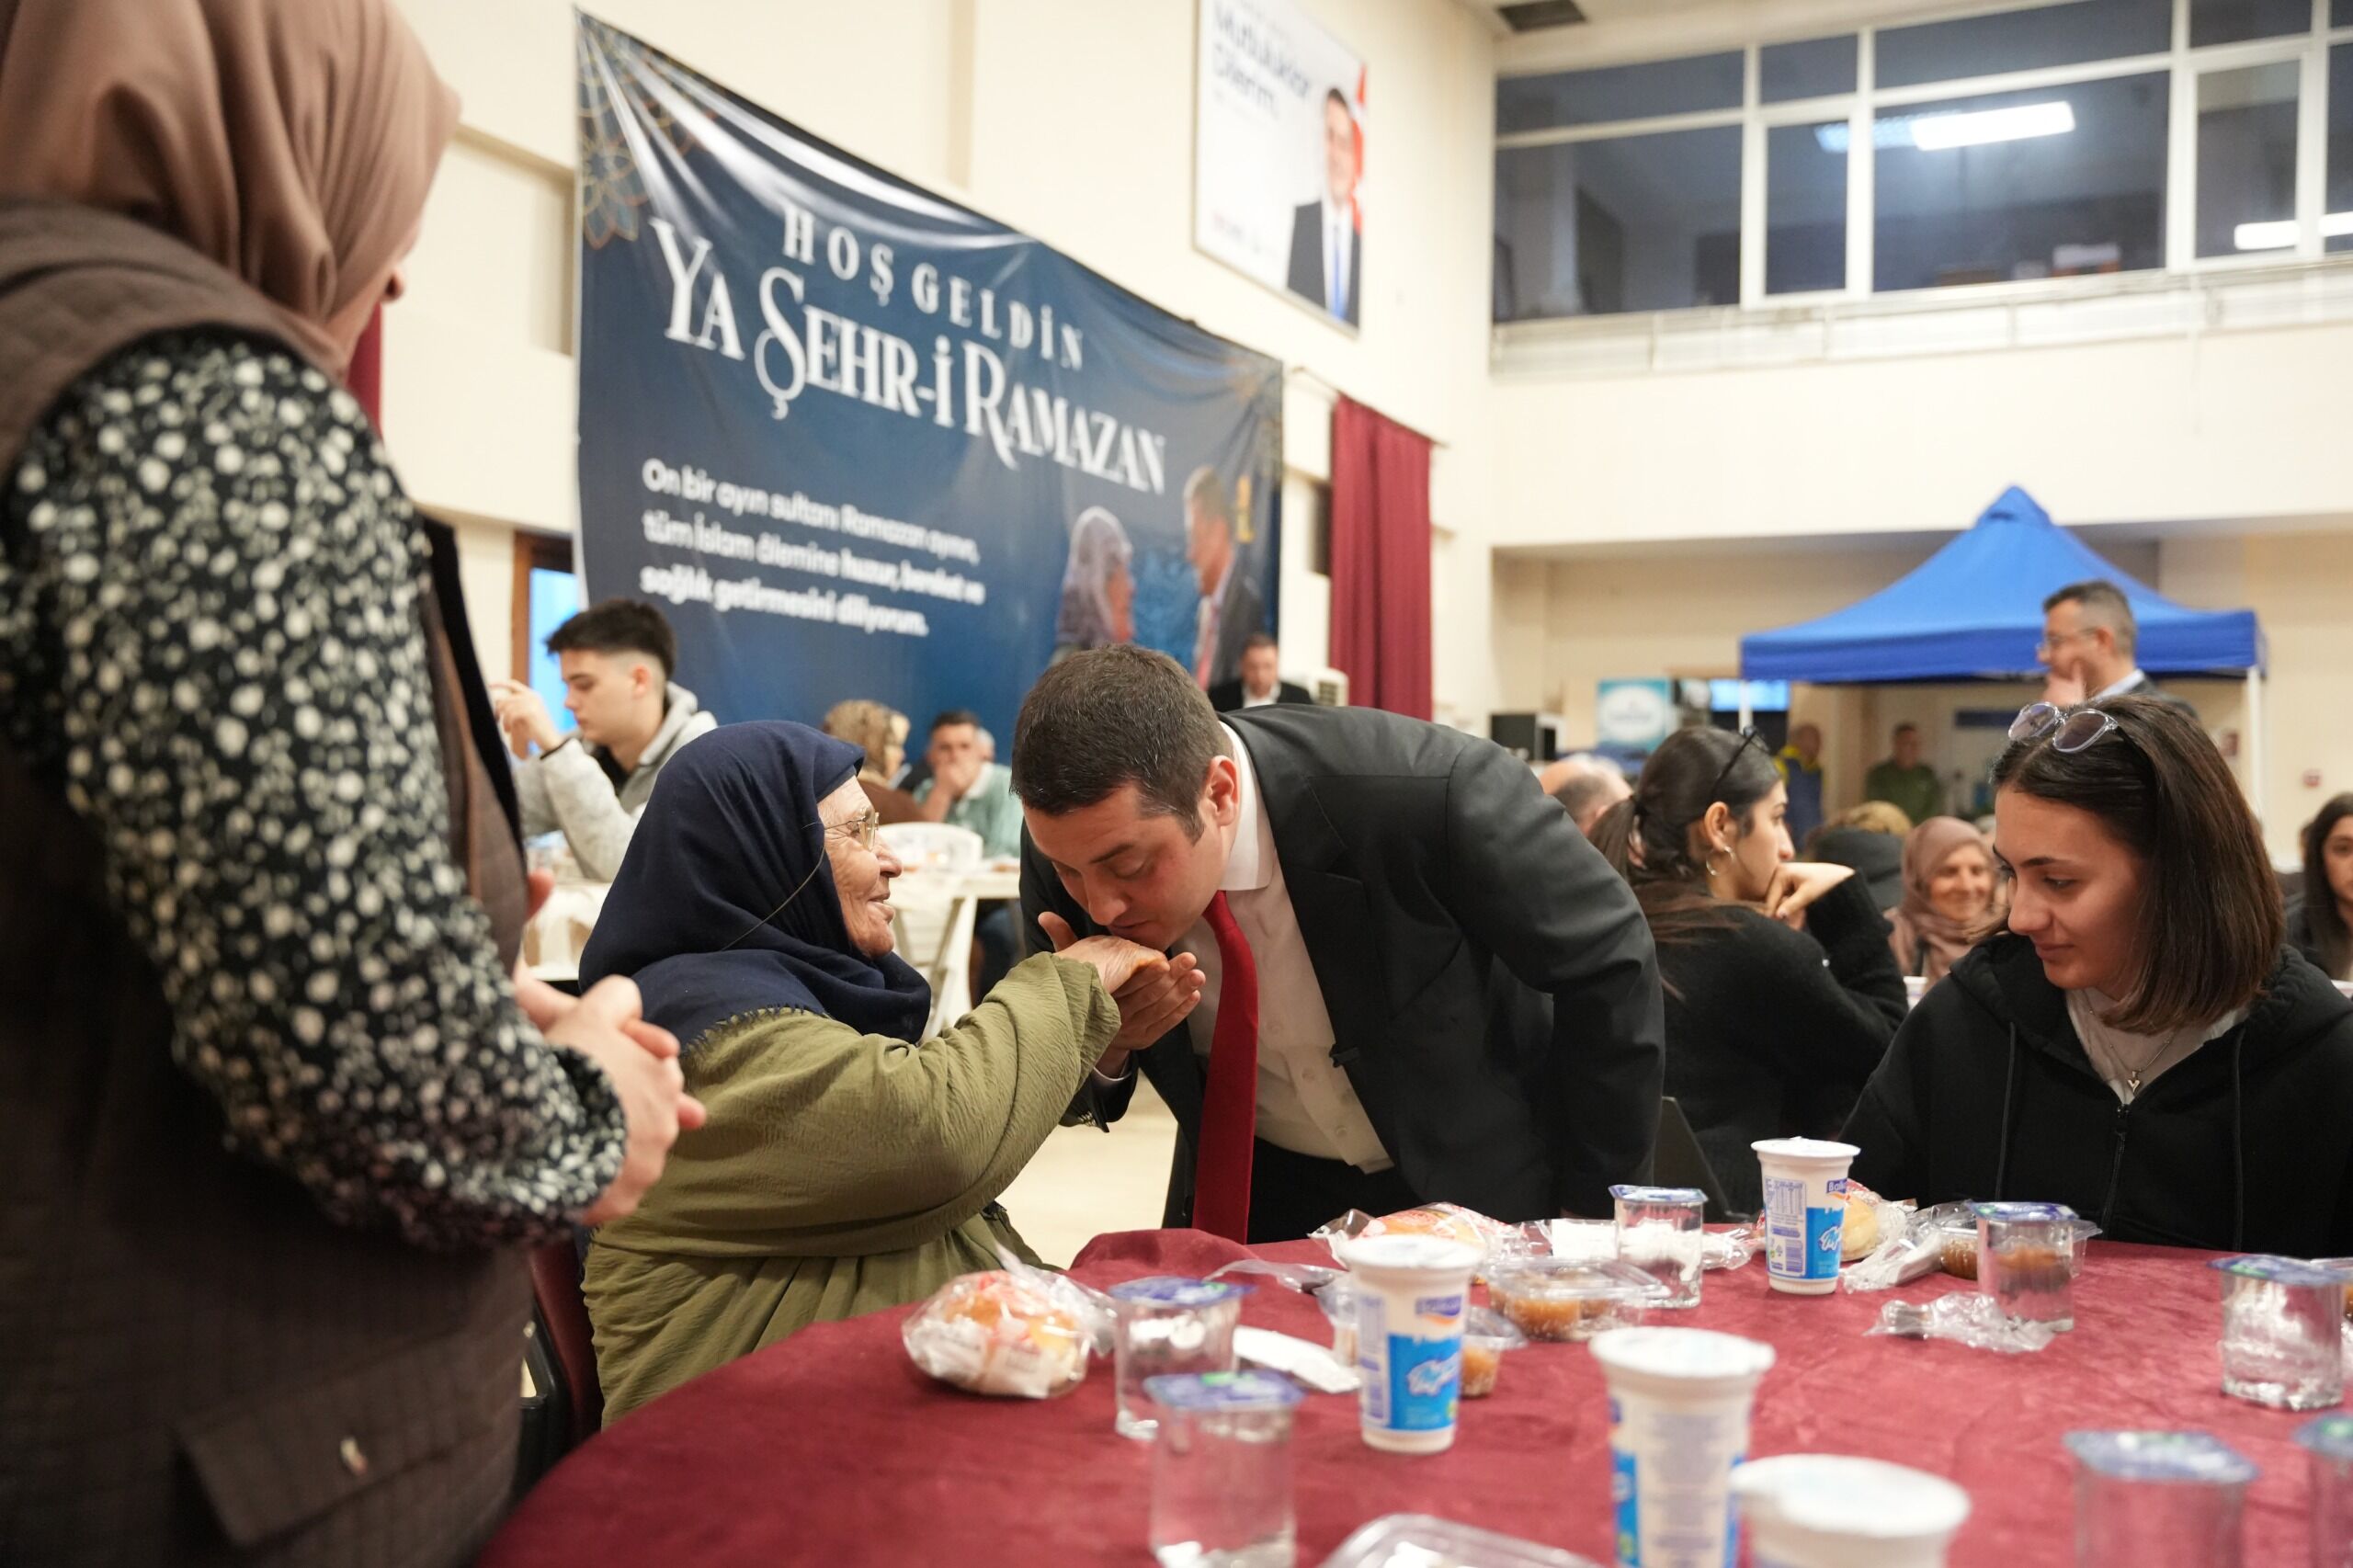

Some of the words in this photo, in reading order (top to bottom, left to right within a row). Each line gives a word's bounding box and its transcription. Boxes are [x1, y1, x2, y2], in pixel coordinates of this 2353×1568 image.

[648, 215, 745, 361] YA
[961, 339, 1165, 495] RAMAZAN
[642, 458, 681, 496] On
[681, 464, 716, 504] bir
[716, 482, 769, 517] ayın
[840, 503, 927, 551] Ramazan
[640, 562, 714, 606] sağlık
[714, 576, 836, 623] getirmesini
[642, 508, 694, 550] tüm
[965, 579, 987, 607] ve
